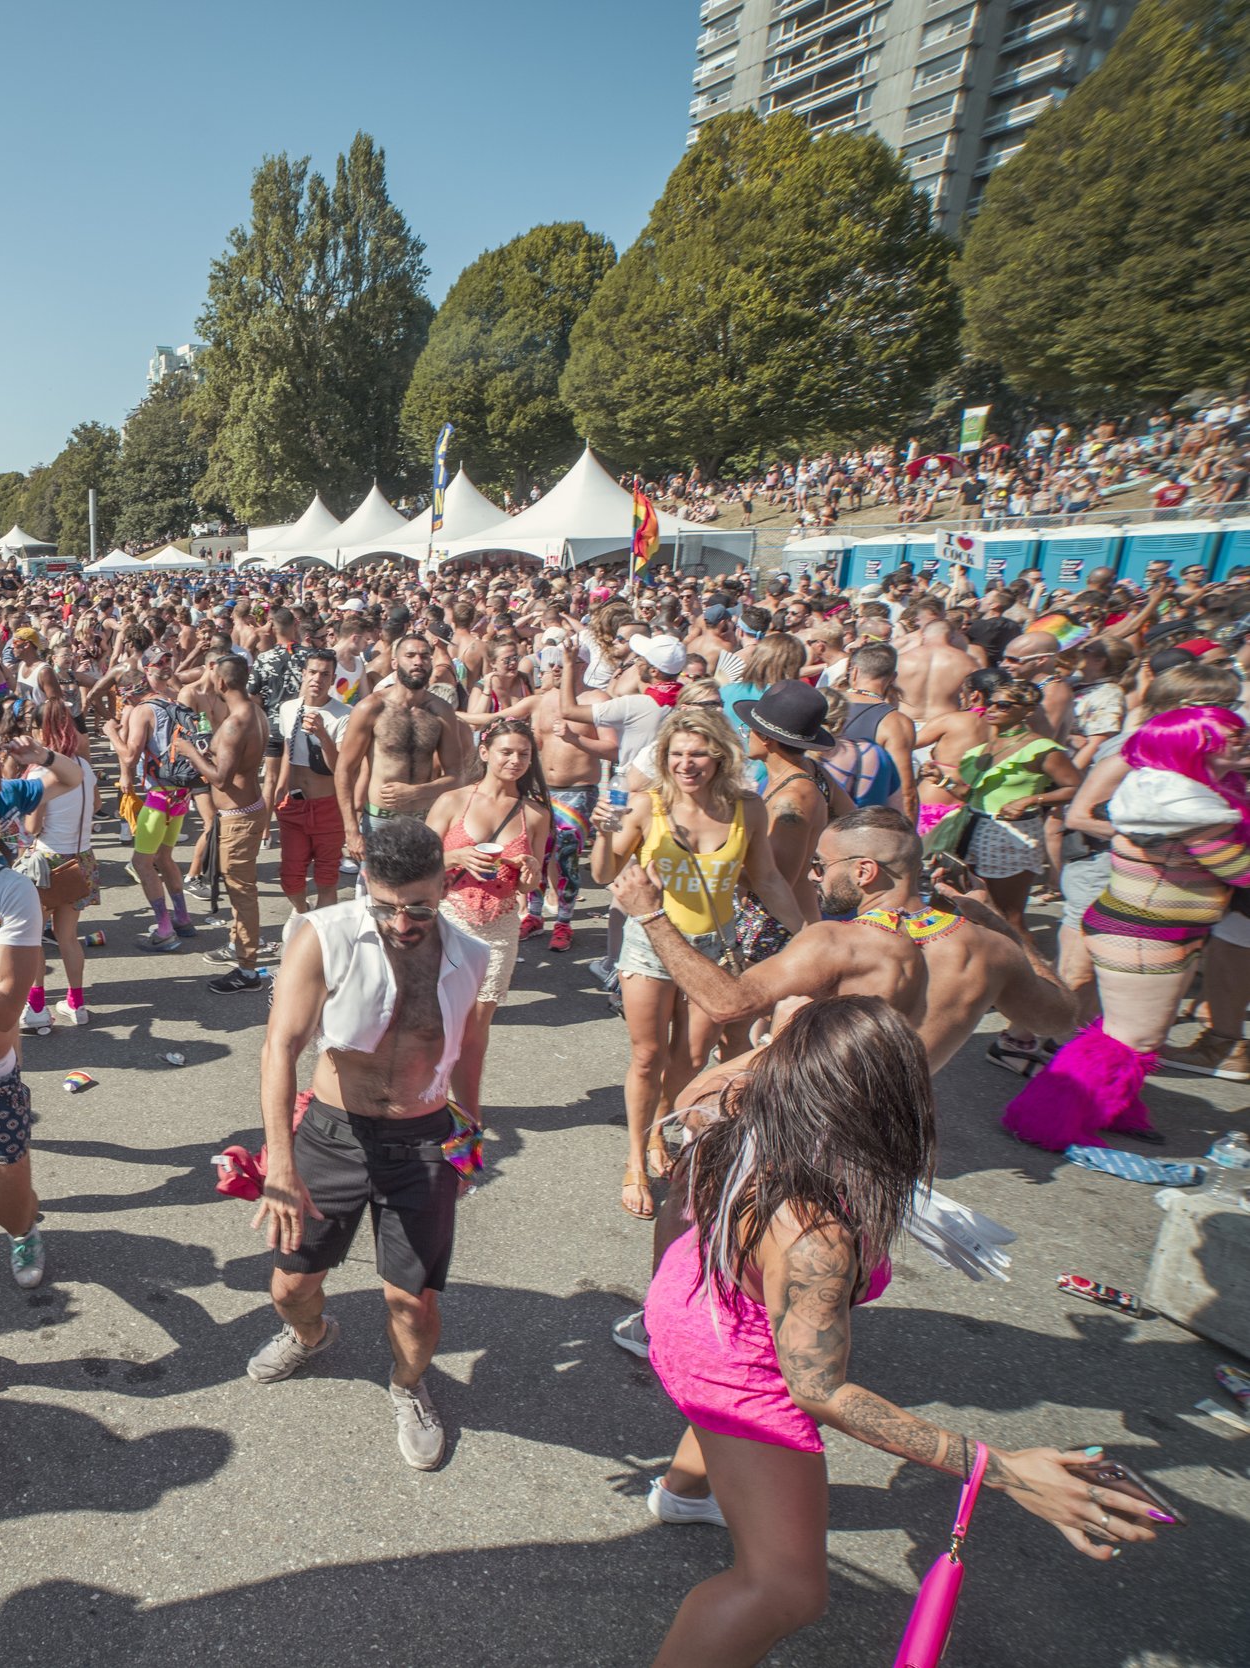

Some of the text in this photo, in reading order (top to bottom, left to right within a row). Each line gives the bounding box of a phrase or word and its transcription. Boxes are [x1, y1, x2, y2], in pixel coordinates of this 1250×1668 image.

[942, 547, 976, 566] COCK
[658, 858, 740, 875] SALTY
[661, 874, 733, 893] VIBES
